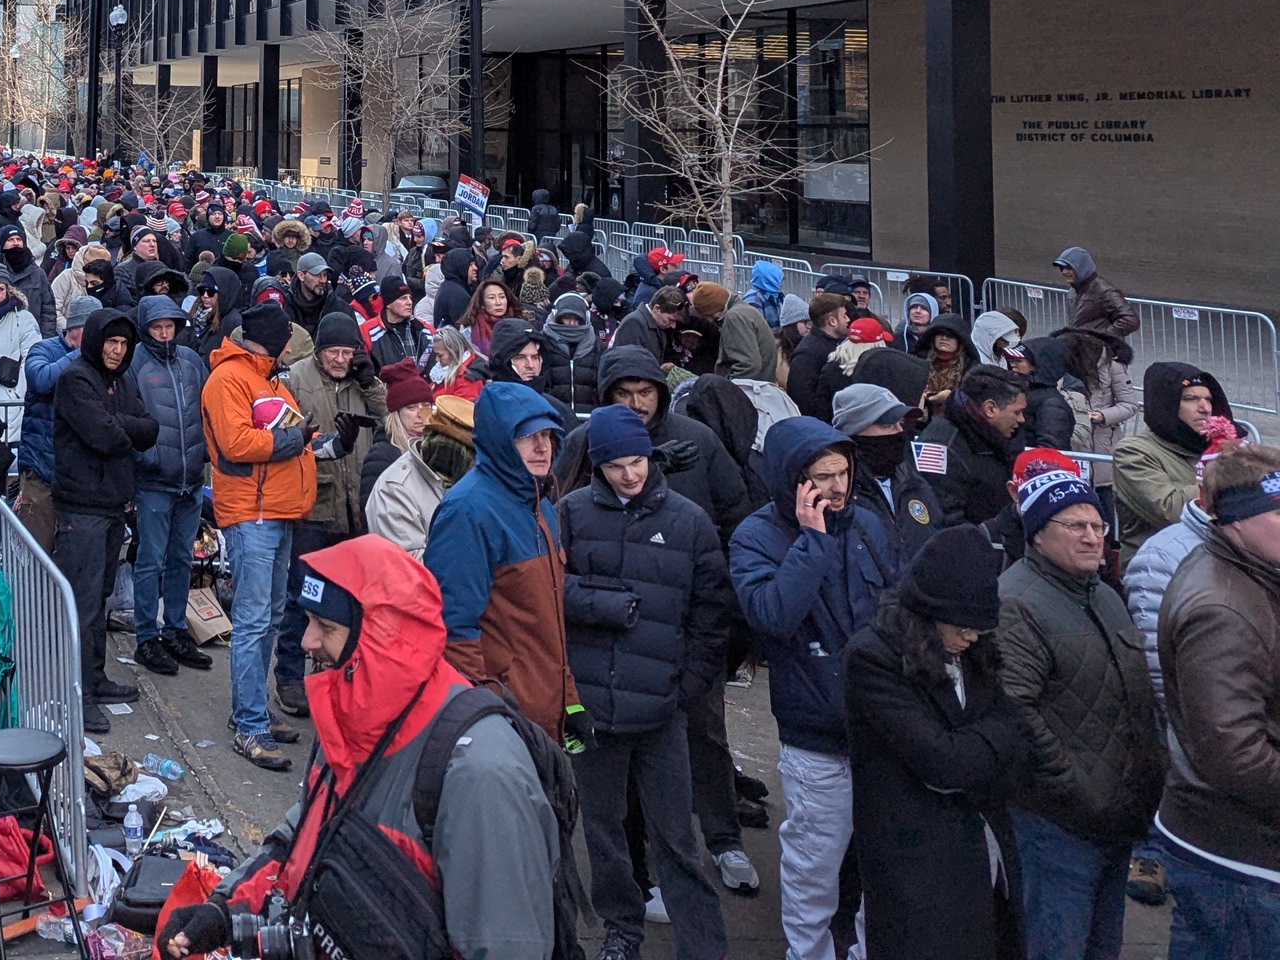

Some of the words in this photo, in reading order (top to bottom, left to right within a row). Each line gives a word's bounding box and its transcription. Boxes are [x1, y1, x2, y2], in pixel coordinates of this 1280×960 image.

[1011, 94, 1052, 103] LUTHER
[1057, 93, 1089, 103] KING,
[1095, 92, 1113, 102] JR.
[1119, 90, 1186, 101] MEMORIAL
[1192, 88, 1252, 99] LIBRARY
[1022, 121, 1043, 129] THE
[1048, 121, 1089, 129] PUBLIC
[1094, 120, 1147, 129] LIBRARY
[1016, 133, 1065, 142] DISTRICT
[1071, 133, 1085, 142] OF
[1091, 133, 1154, 142] COLUMBIA
[458, 189, 486, 209] JORDAN
[1048, 483, 1089, 503] 45-47
